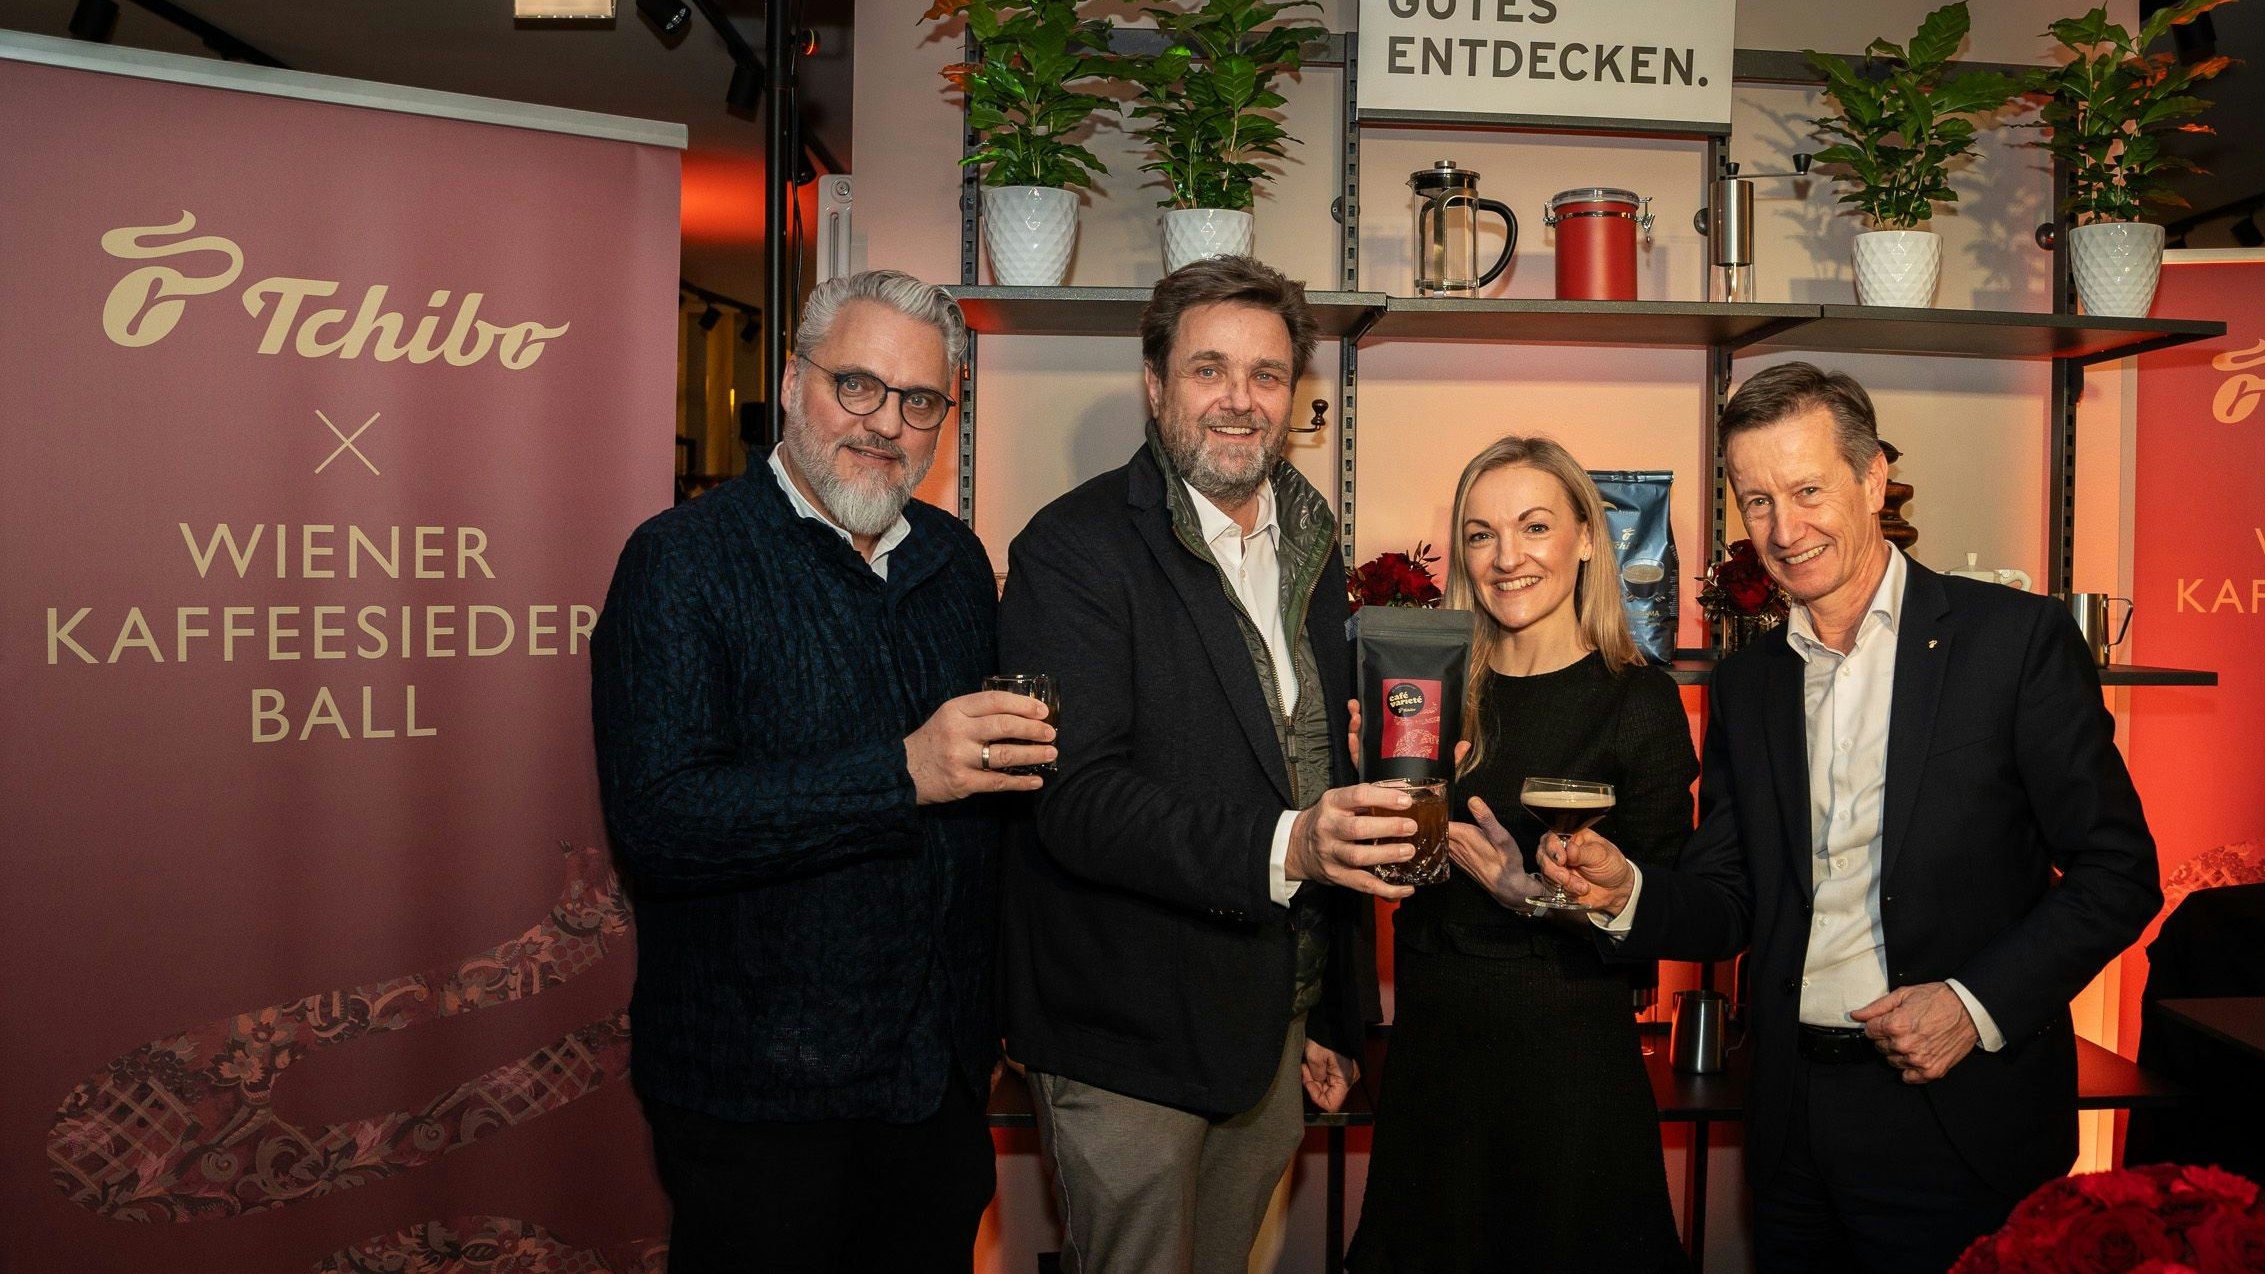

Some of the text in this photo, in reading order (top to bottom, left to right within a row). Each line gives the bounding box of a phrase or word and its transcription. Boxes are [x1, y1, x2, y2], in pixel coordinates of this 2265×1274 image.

[1387, 36, 1708, 87] ENTDECKEN.
[242, 277, 570, 370] Tchibo
[179, 523, 496, 579] WIENER
[47, 605, 598, 665] KAFFEESIEDER
[251, 685, 437, 743] BALL
[1389, 691, 1408, 702] café
[1390, 695, 1423, 708] varieté
